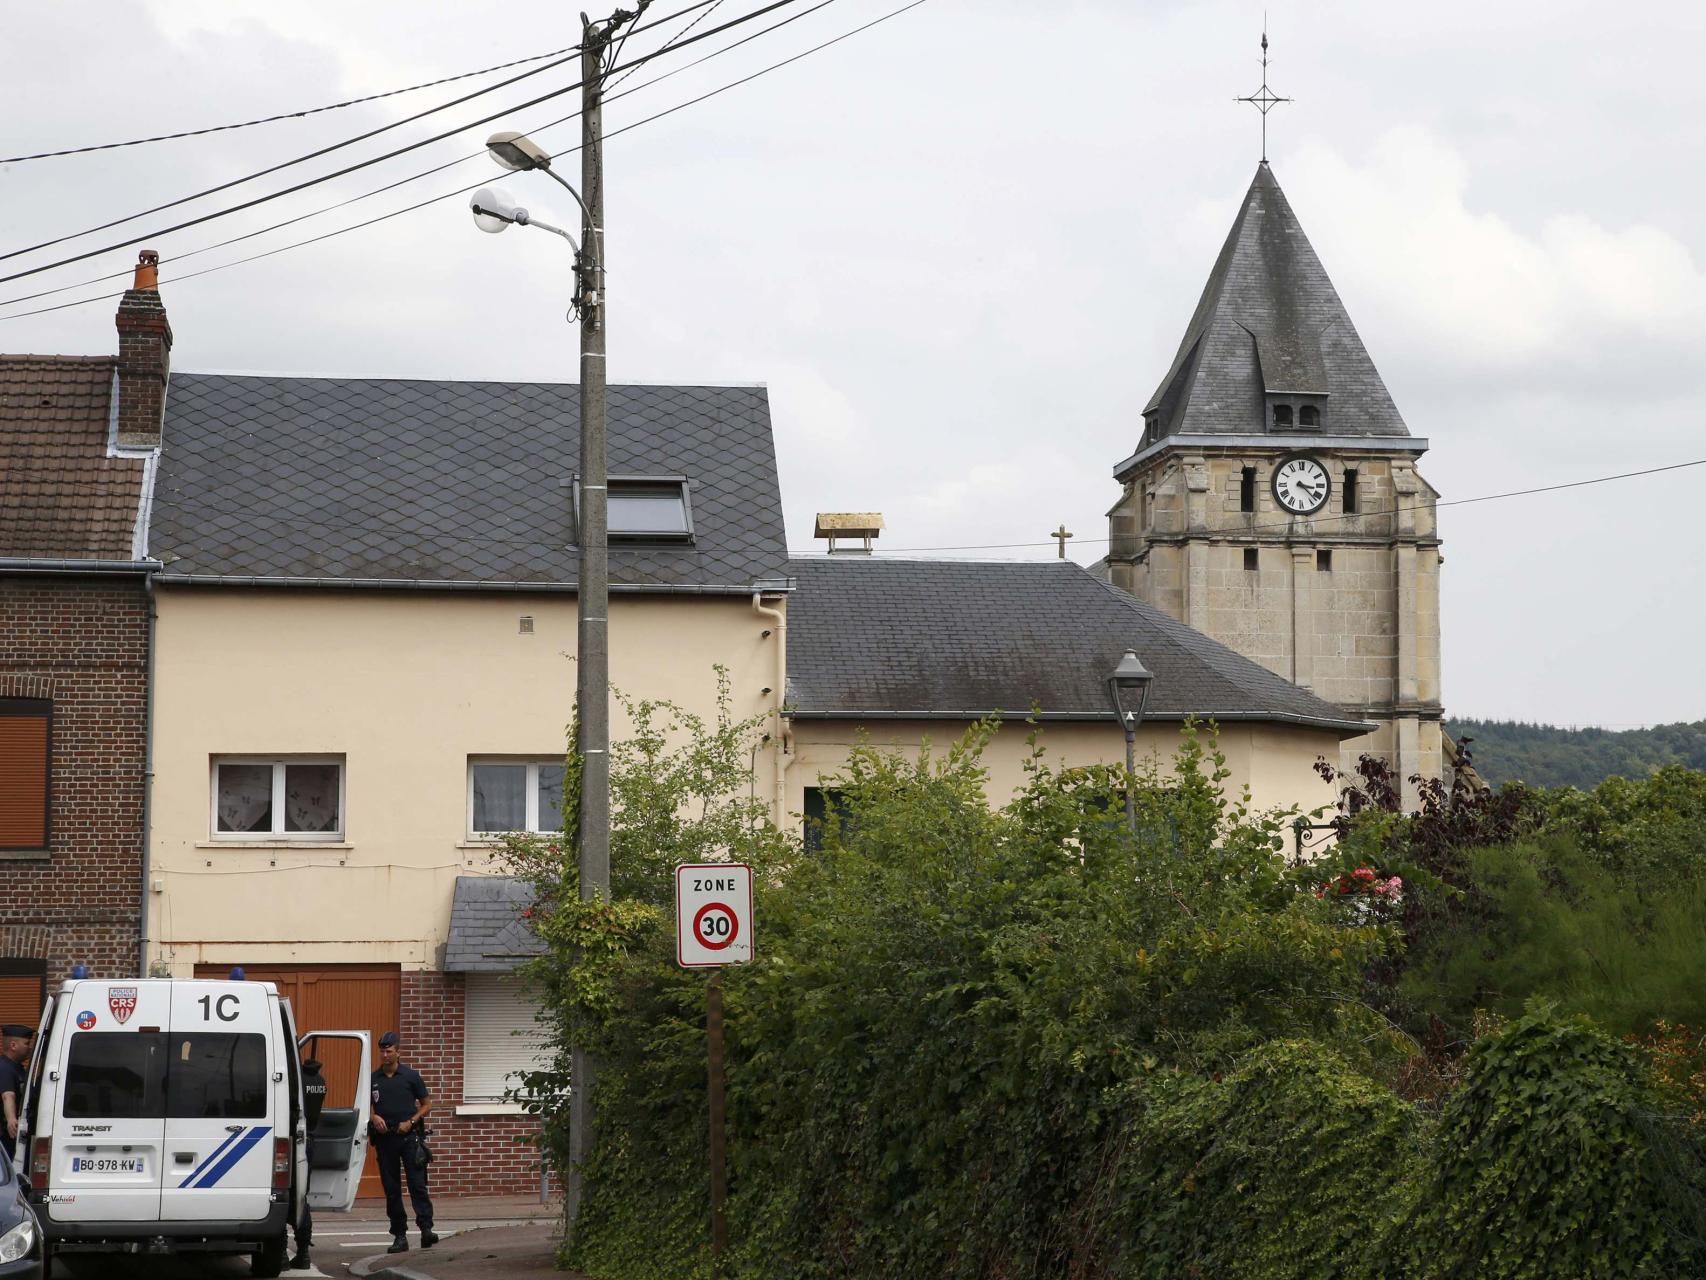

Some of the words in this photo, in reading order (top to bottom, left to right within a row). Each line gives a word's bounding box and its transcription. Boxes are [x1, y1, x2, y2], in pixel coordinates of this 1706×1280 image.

[694, 879, 736, 892] ZONE
[702, 916, 730, 937] 30
[110, 998, 135, 1008] CRS
[197, 994, 240, 1022] 1C
[306, 1085, 327, 1094] POLICE
